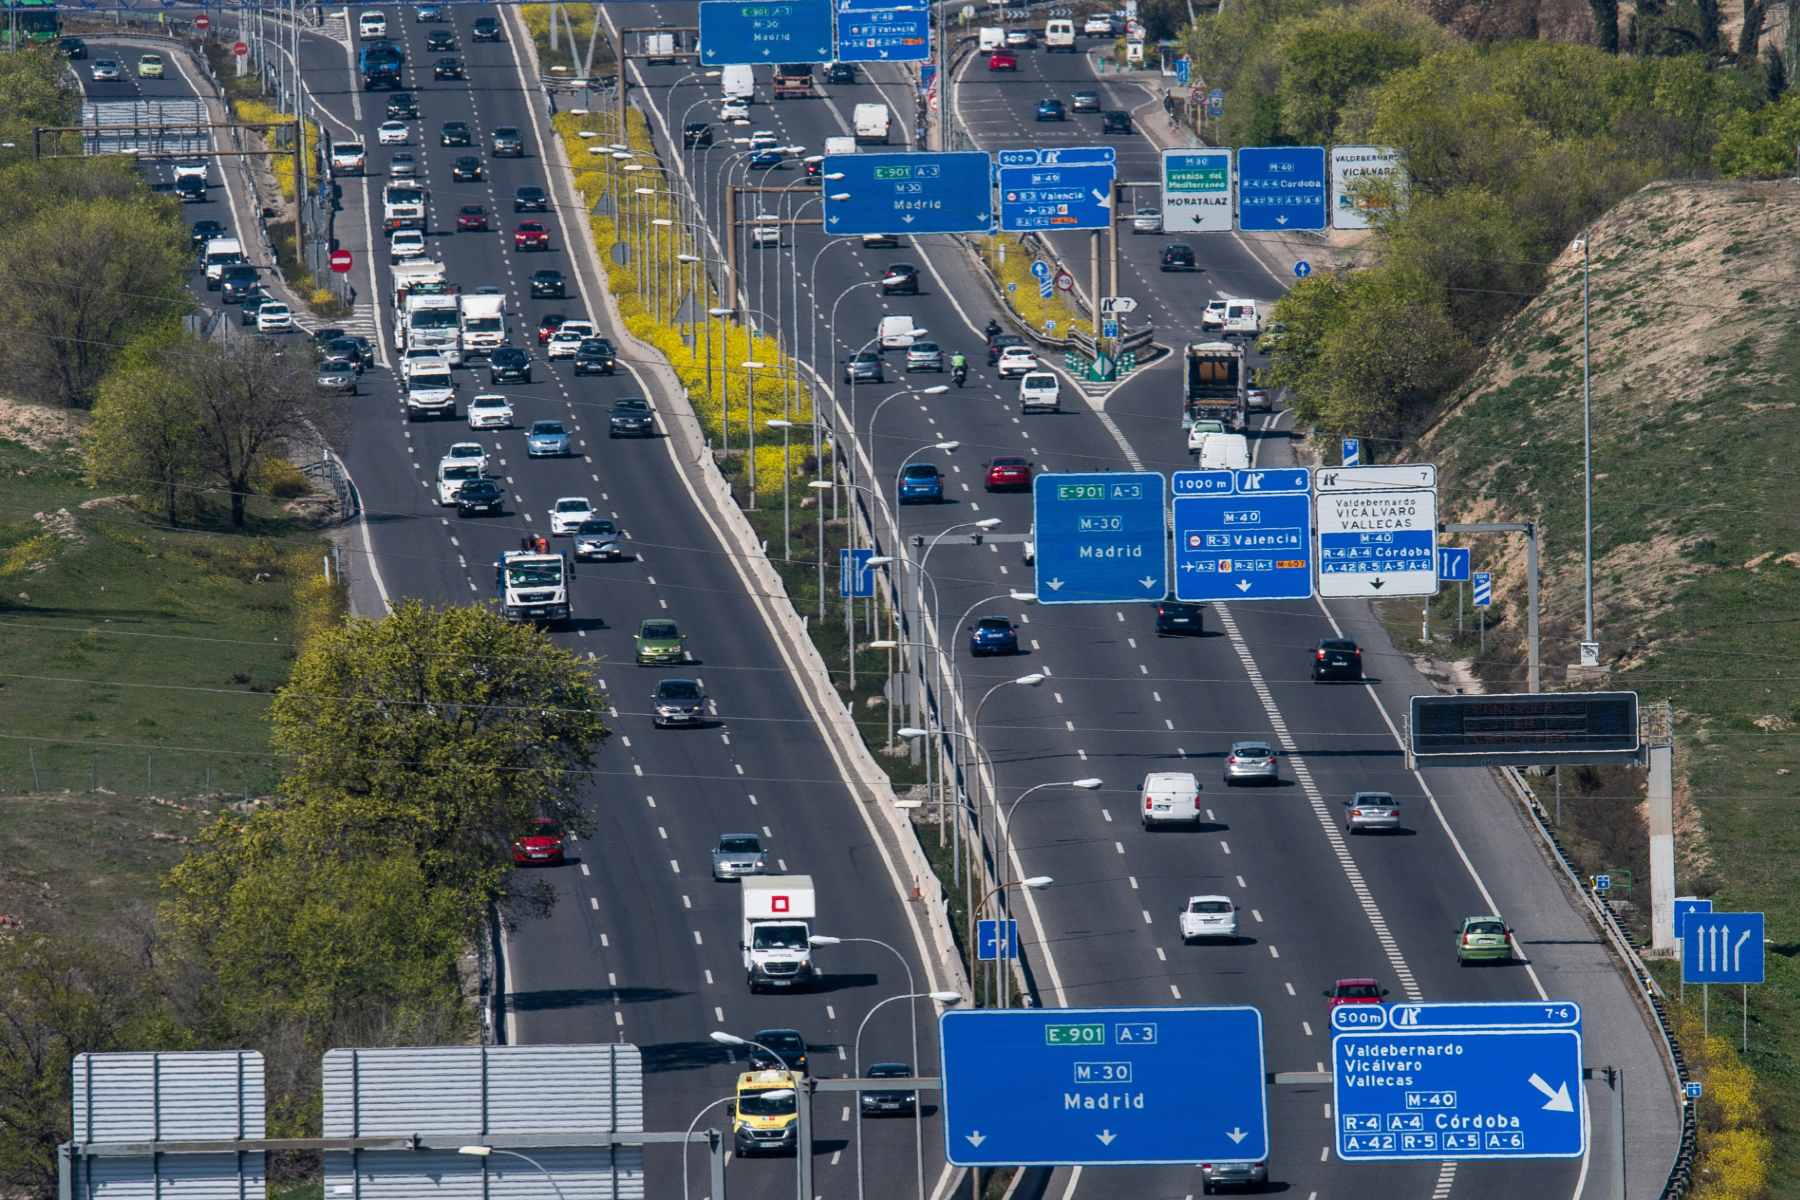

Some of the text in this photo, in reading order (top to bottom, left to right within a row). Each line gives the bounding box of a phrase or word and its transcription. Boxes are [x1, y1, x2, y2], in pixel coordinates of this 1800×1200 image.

[895, 201, 941, 209] Madrid
[1168, 197, 1227, 206] MORATALAZ
[1123, 300, 1131, 310] 7
[1420, 472, 1428, 480] 7
[1180, 479, 1213, 489] 1000
[1295, 477, 1303, 486] 6
[1060, 486, 1140, 498] E-901 A-3
[1336, 498, 1417, 508] Valdebernardo
[1225, 512, 1259, 522] M-40
[1081, 518, 1121, 530] M-30
[1342, 519, 1412, 530] VALLECAS
[1207, 534, 1298, 546] R-3 Valencia
[1361, 533, 1392, 543] M-40
[1080, 545, 1142, 558] Madrid
[1323, 546, 1431, 559] R-4 A-4 Córdoba
[1409, 560, 1429, 570] A-6
[1545, 1008, 1569, 1019] 7-6
[1049, 1027, 1153, 1042] E-901 A-3
[1344, 1043, 1464, 1057] Valdebernardo
[1344, 1059, 1422, 1073] Vicálvaro
[1076, 1066, 1128, 1080] M-30
[1345, 1074, 1414, 1088] Vallecas
[1063, 1092, 1145, 1110] Madrid
[1407, 1094, 1454, 1107] M-40
[1345, 1111, 1520, 1129] R-4 A-4 Córdoba
[1347, 1133, 1521, 1150] A-42 R-5 A-5 A-6
